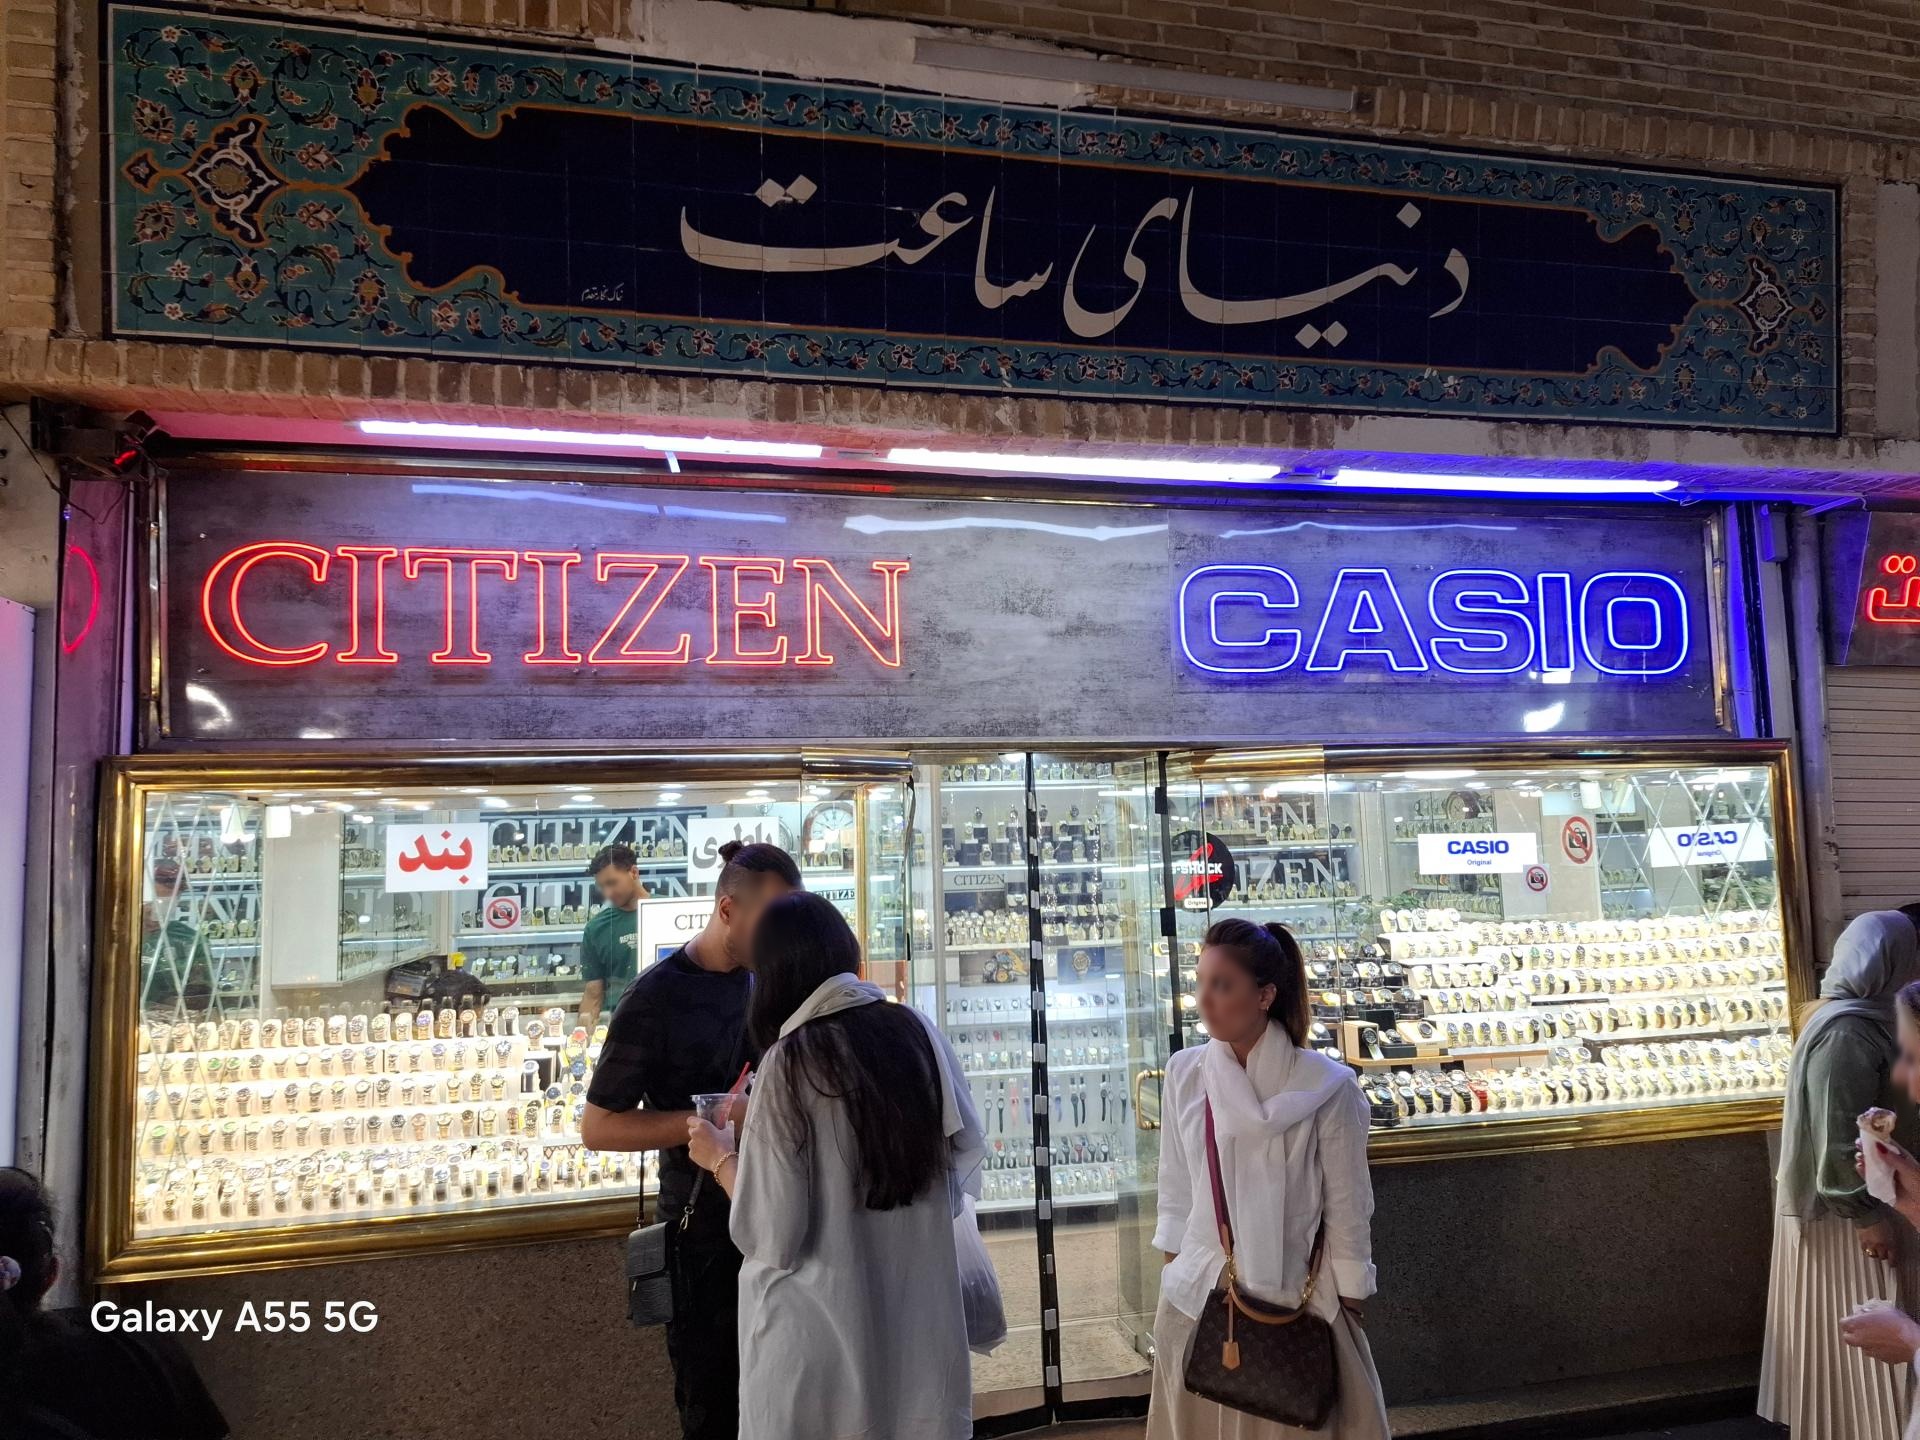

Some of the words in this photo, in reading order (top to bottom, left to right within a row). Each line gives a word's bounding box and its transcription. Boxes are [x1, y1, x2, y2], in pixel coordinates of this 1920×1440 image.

[680, 174, 1054, 309] ساعت
[1063, 186, 1470, 349] دنیای
[203, 542, 911, 667] CITIZEN
[1179, 564, 1689, 675] CASIO
[399, 830, 474, 885] بند
[953, 873, 1006, 887] CITIZEN
[1447, 840, 1510, 855] CASIO
